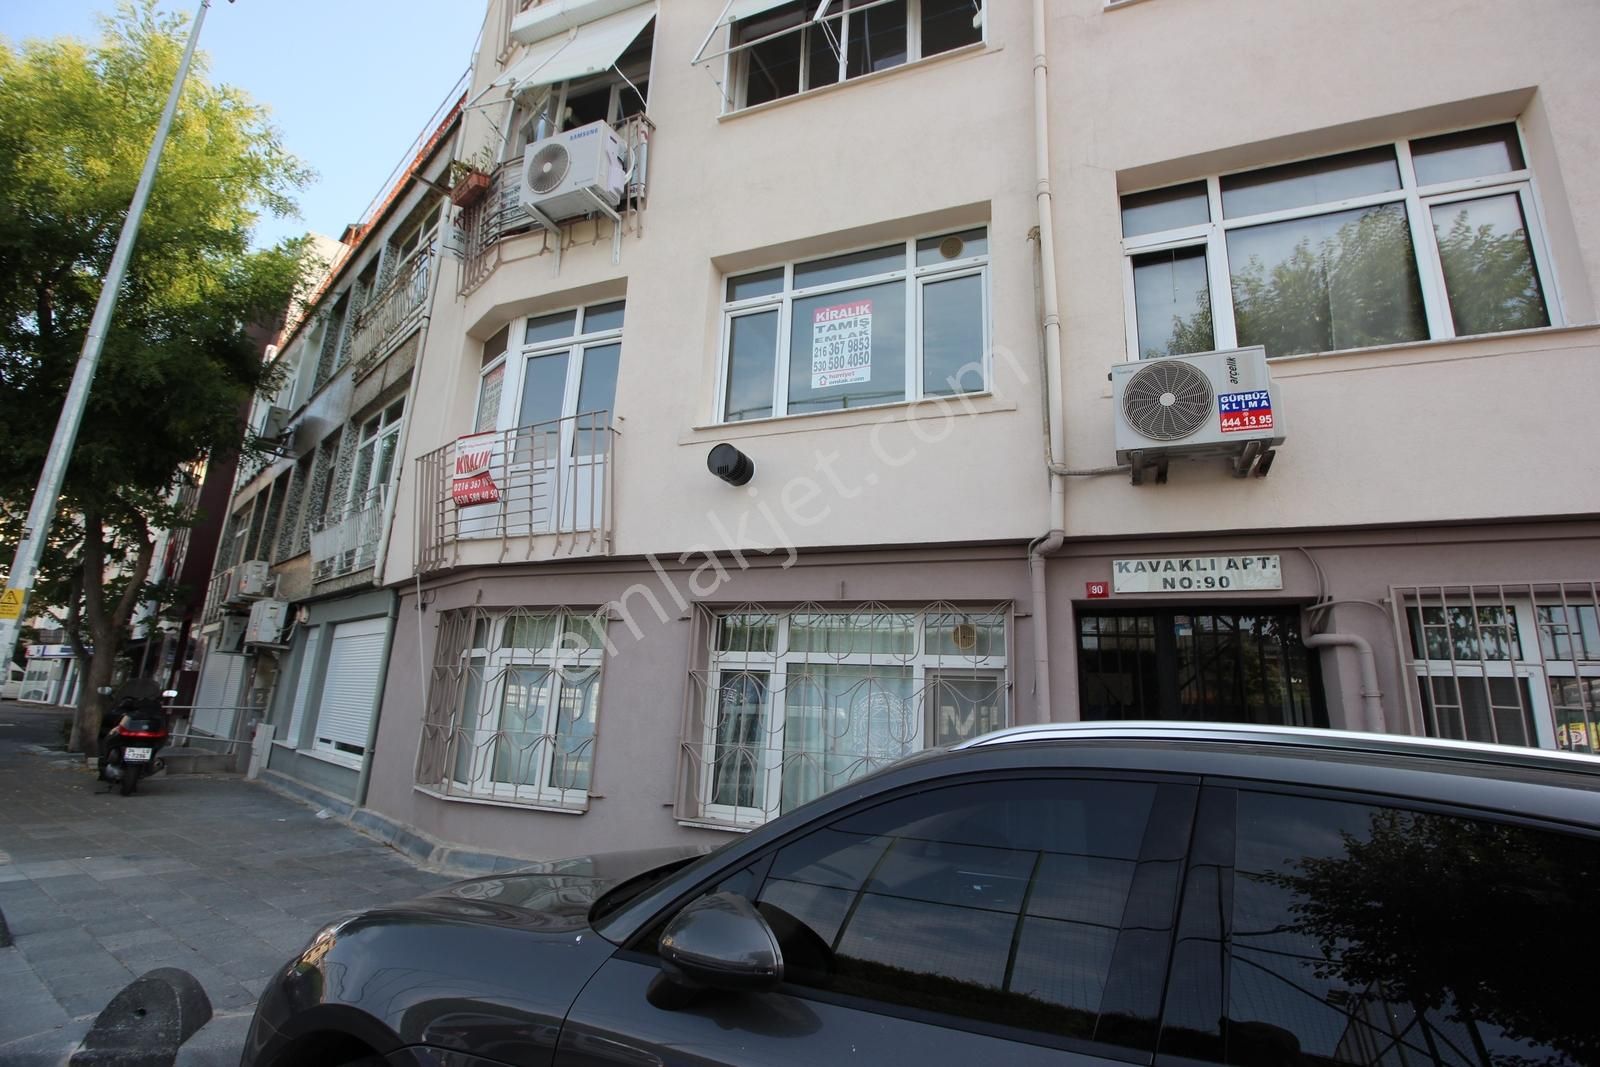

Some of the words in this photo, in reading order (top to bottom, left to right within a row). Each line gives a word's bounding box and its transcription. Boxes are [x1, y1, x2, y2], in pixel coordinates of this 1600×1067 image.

[569, 127, 599, 141] SAMSUNG
[814, 330, 869, 344] EMLAK
[814, 346, 828, 358] 216
[828, 341, 846, 356] 367
[847, 336, 870, 354] 9853
[813, 360, 827, 372] 530
[828, 355, 845, 370] 580
[847, 350, 870, 367] 4050
[1226, 356, 1239, 385] arçelik
[1220, 392, 1268, 403] GÜRBÜZ
[1221, 417, 1241, 428] 444
[1243, 415, 1257, 426] 13
[1258, 414, 1272, 424] 95
[453, 482, 469, 492] 0216
[470, 479, 481, 489] 367
[490, 488, 498, 498] 50
[1117, 558, 1217, 574] KAVAKLI
[1162, 575, 1231, 590] NO:90
[1091, 586, 1103, 594] 90
